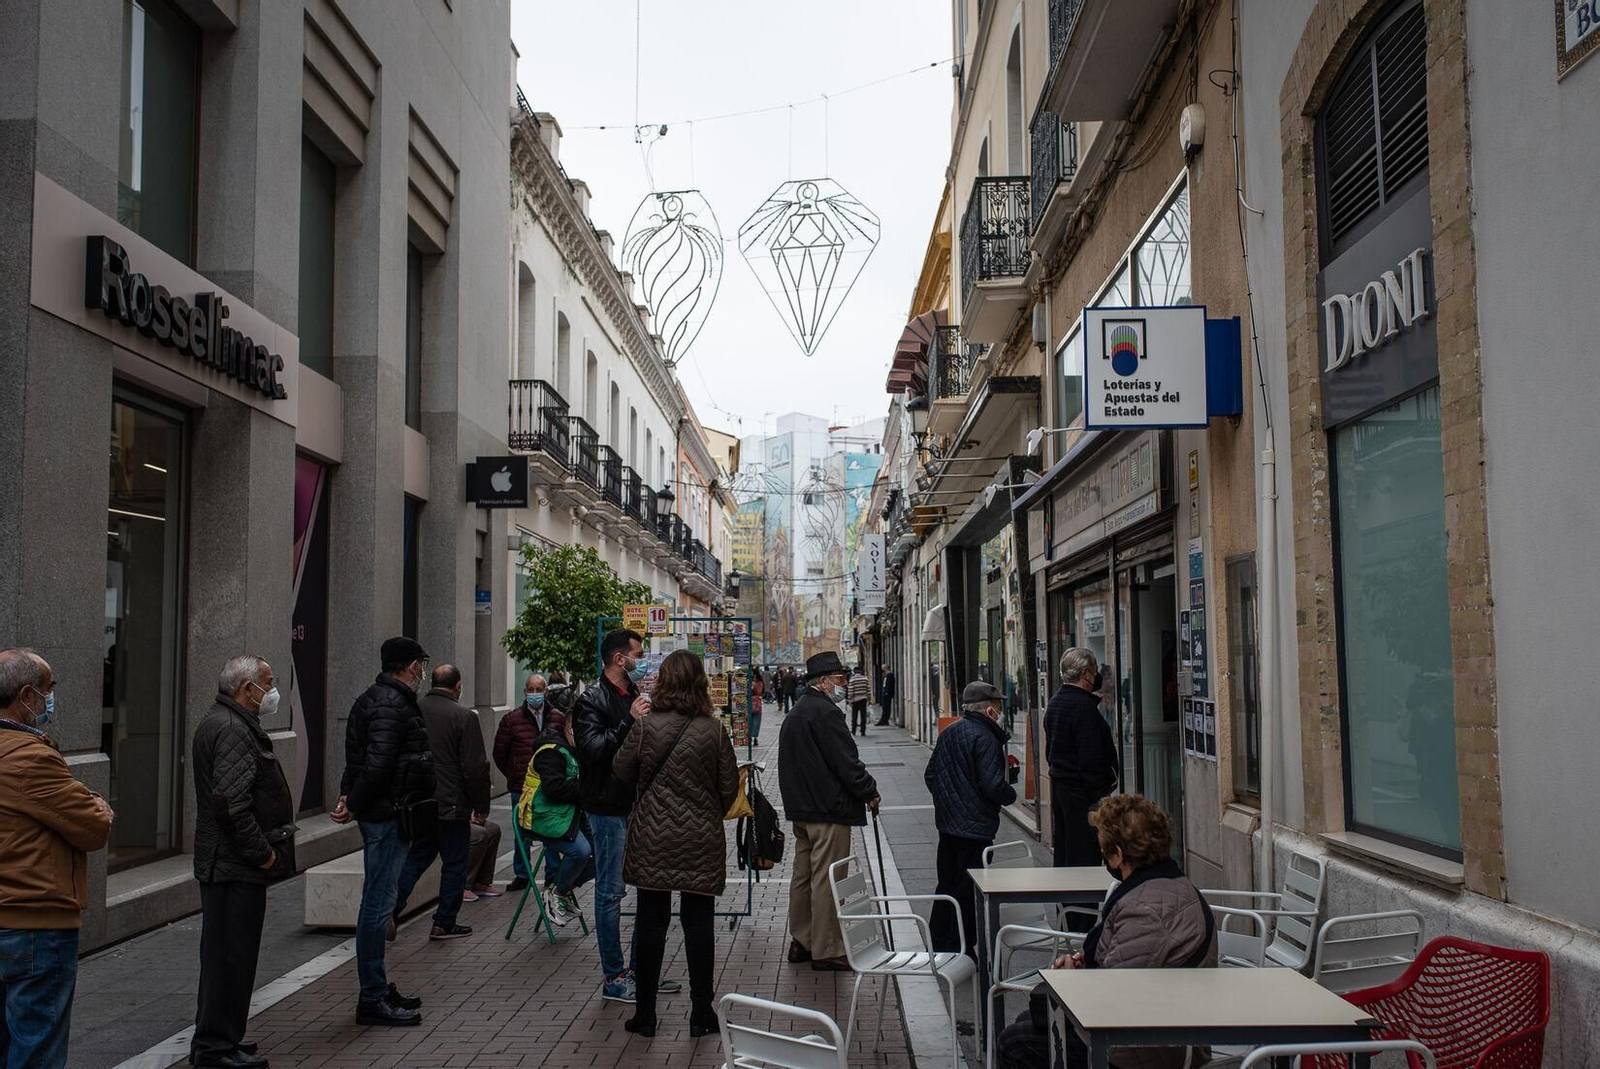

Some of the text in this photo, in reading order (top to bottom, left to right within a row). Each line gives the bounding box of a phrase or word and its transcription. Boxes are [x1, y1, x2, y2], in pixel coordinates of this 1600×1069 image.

[1322, 248, 1428, 373] DIONI
[1103, 379, 1161, 392] Loterías y
[1104, 392, 1180, 406] Apuestas del
[1104, 406, 1145, 417] Estado
[870, 542, 880, 589] NOVIAS
[651, 608, 665, 622] 10
